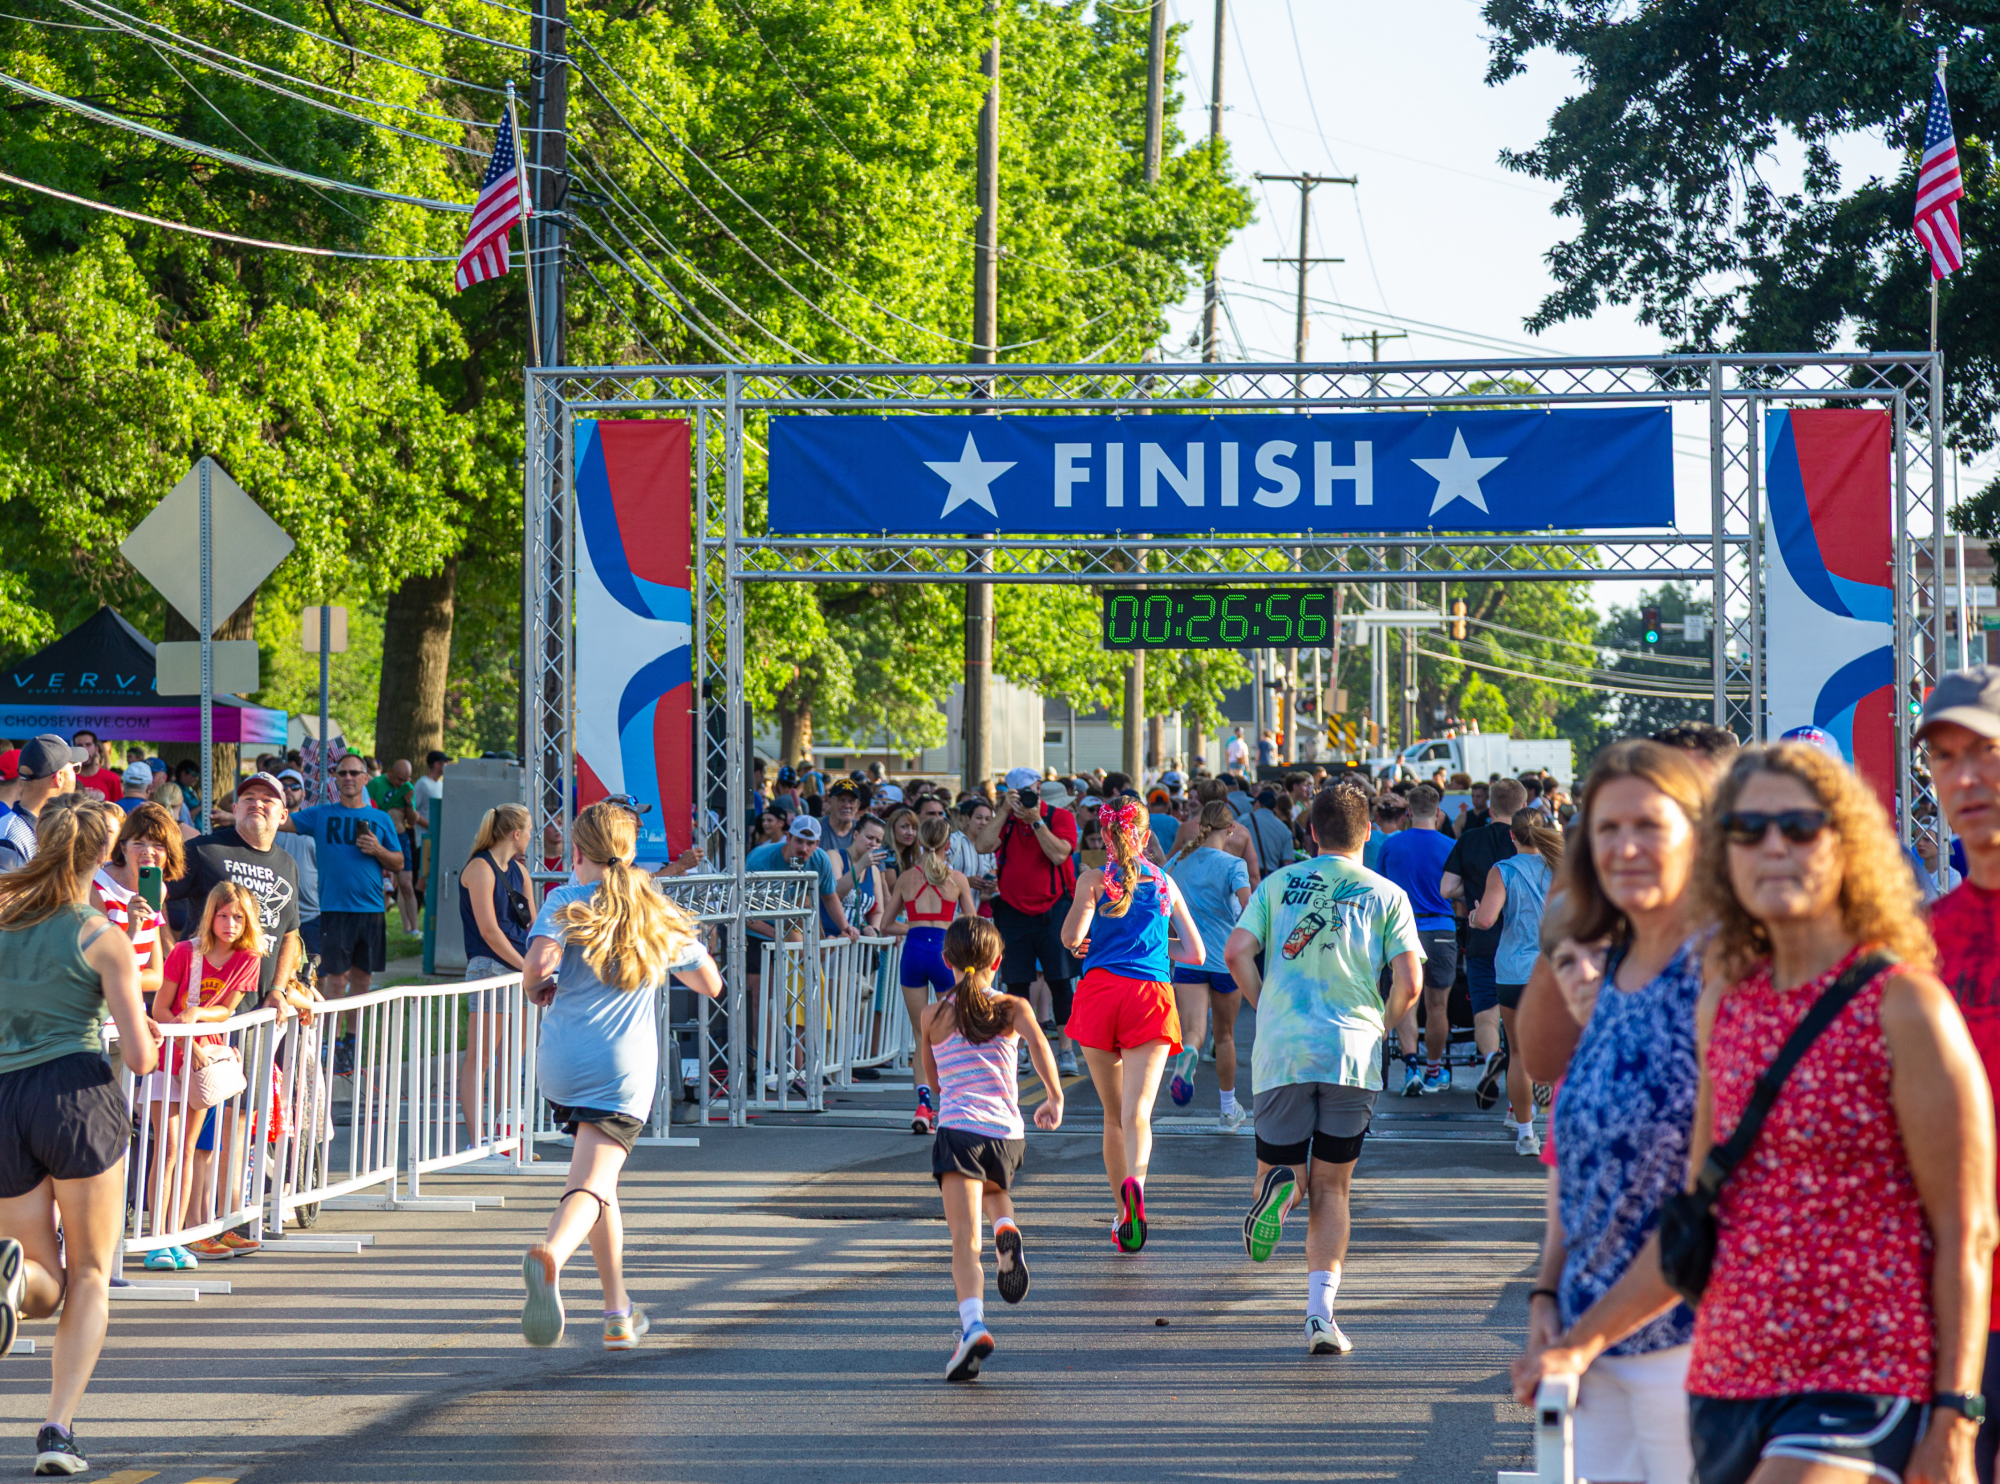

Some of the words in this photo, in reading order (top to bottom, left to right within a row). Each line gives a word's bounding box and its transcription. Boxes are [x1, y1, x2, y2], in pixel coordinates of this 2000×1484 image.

[1053, 439, 1374, 509] FINISH
[1108, 594, 1327, 643] 00:26:56
[4, 715, 150, 729] CHOOSEVERVE.COM
[223, 859, 275, 882] FATHER
[231, 874, 274, 895] MOWS
